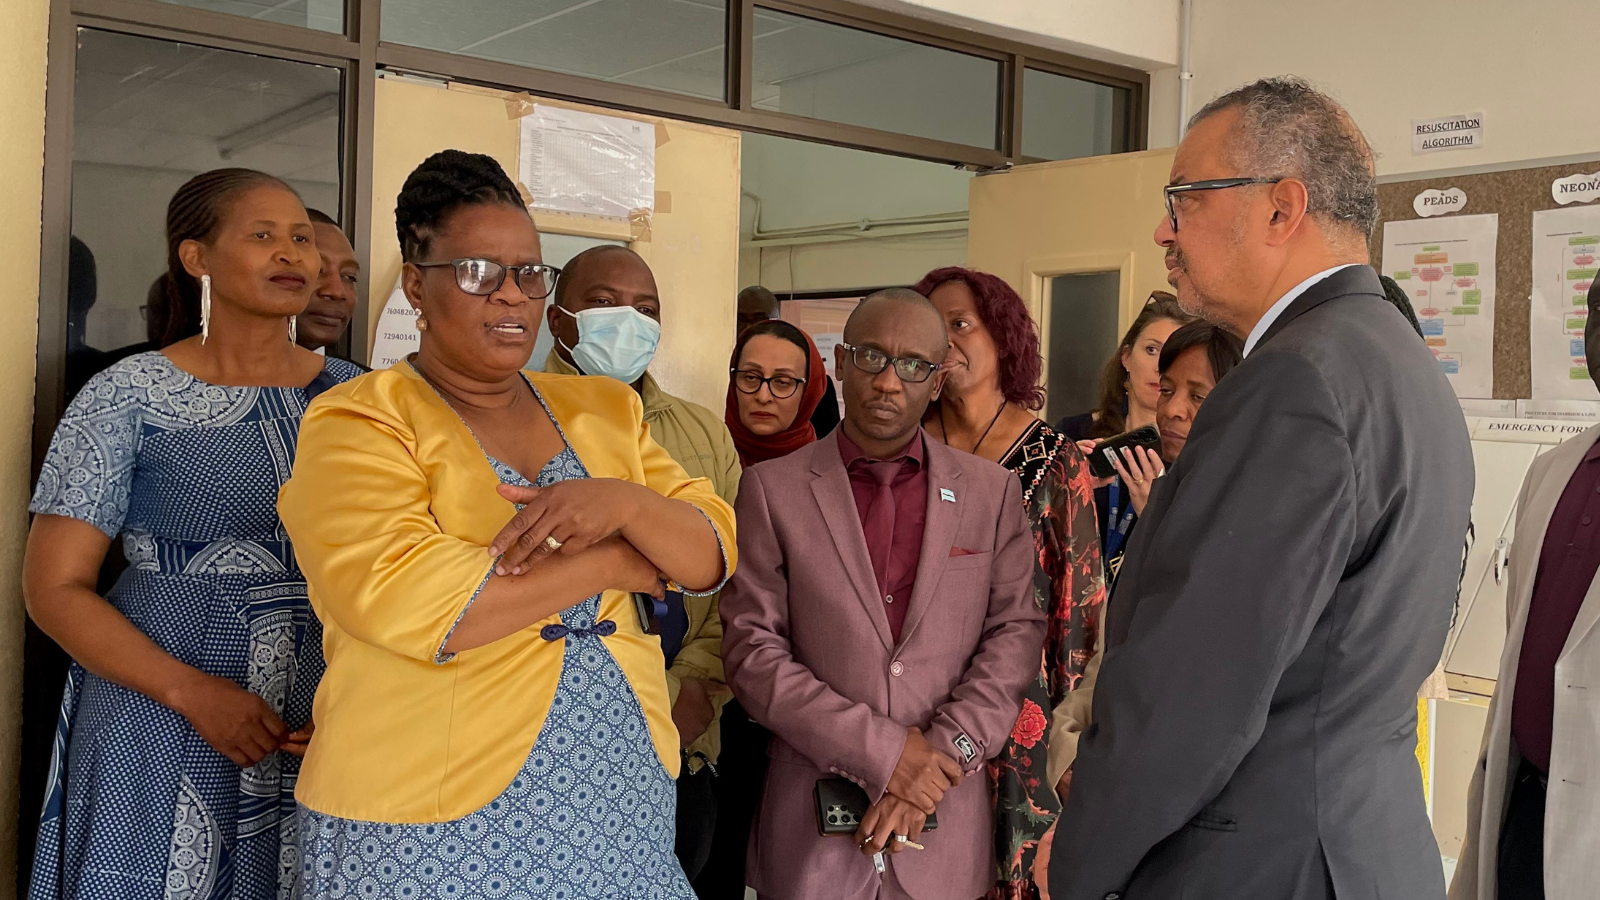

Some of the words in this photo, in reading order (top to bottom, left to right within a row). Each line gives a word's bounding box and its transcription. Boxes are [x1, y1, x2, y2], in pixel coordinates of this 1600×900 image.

[1416, 119, 1480, 135] RESUSCITATION
[1422, 135, 1473, 149] ALGORITHM
[1423, 195, 1459, 206] PEADS
[383, 333, 416, 341] 72940141
[1488, 422, 1559, 433] EMERGENCY
